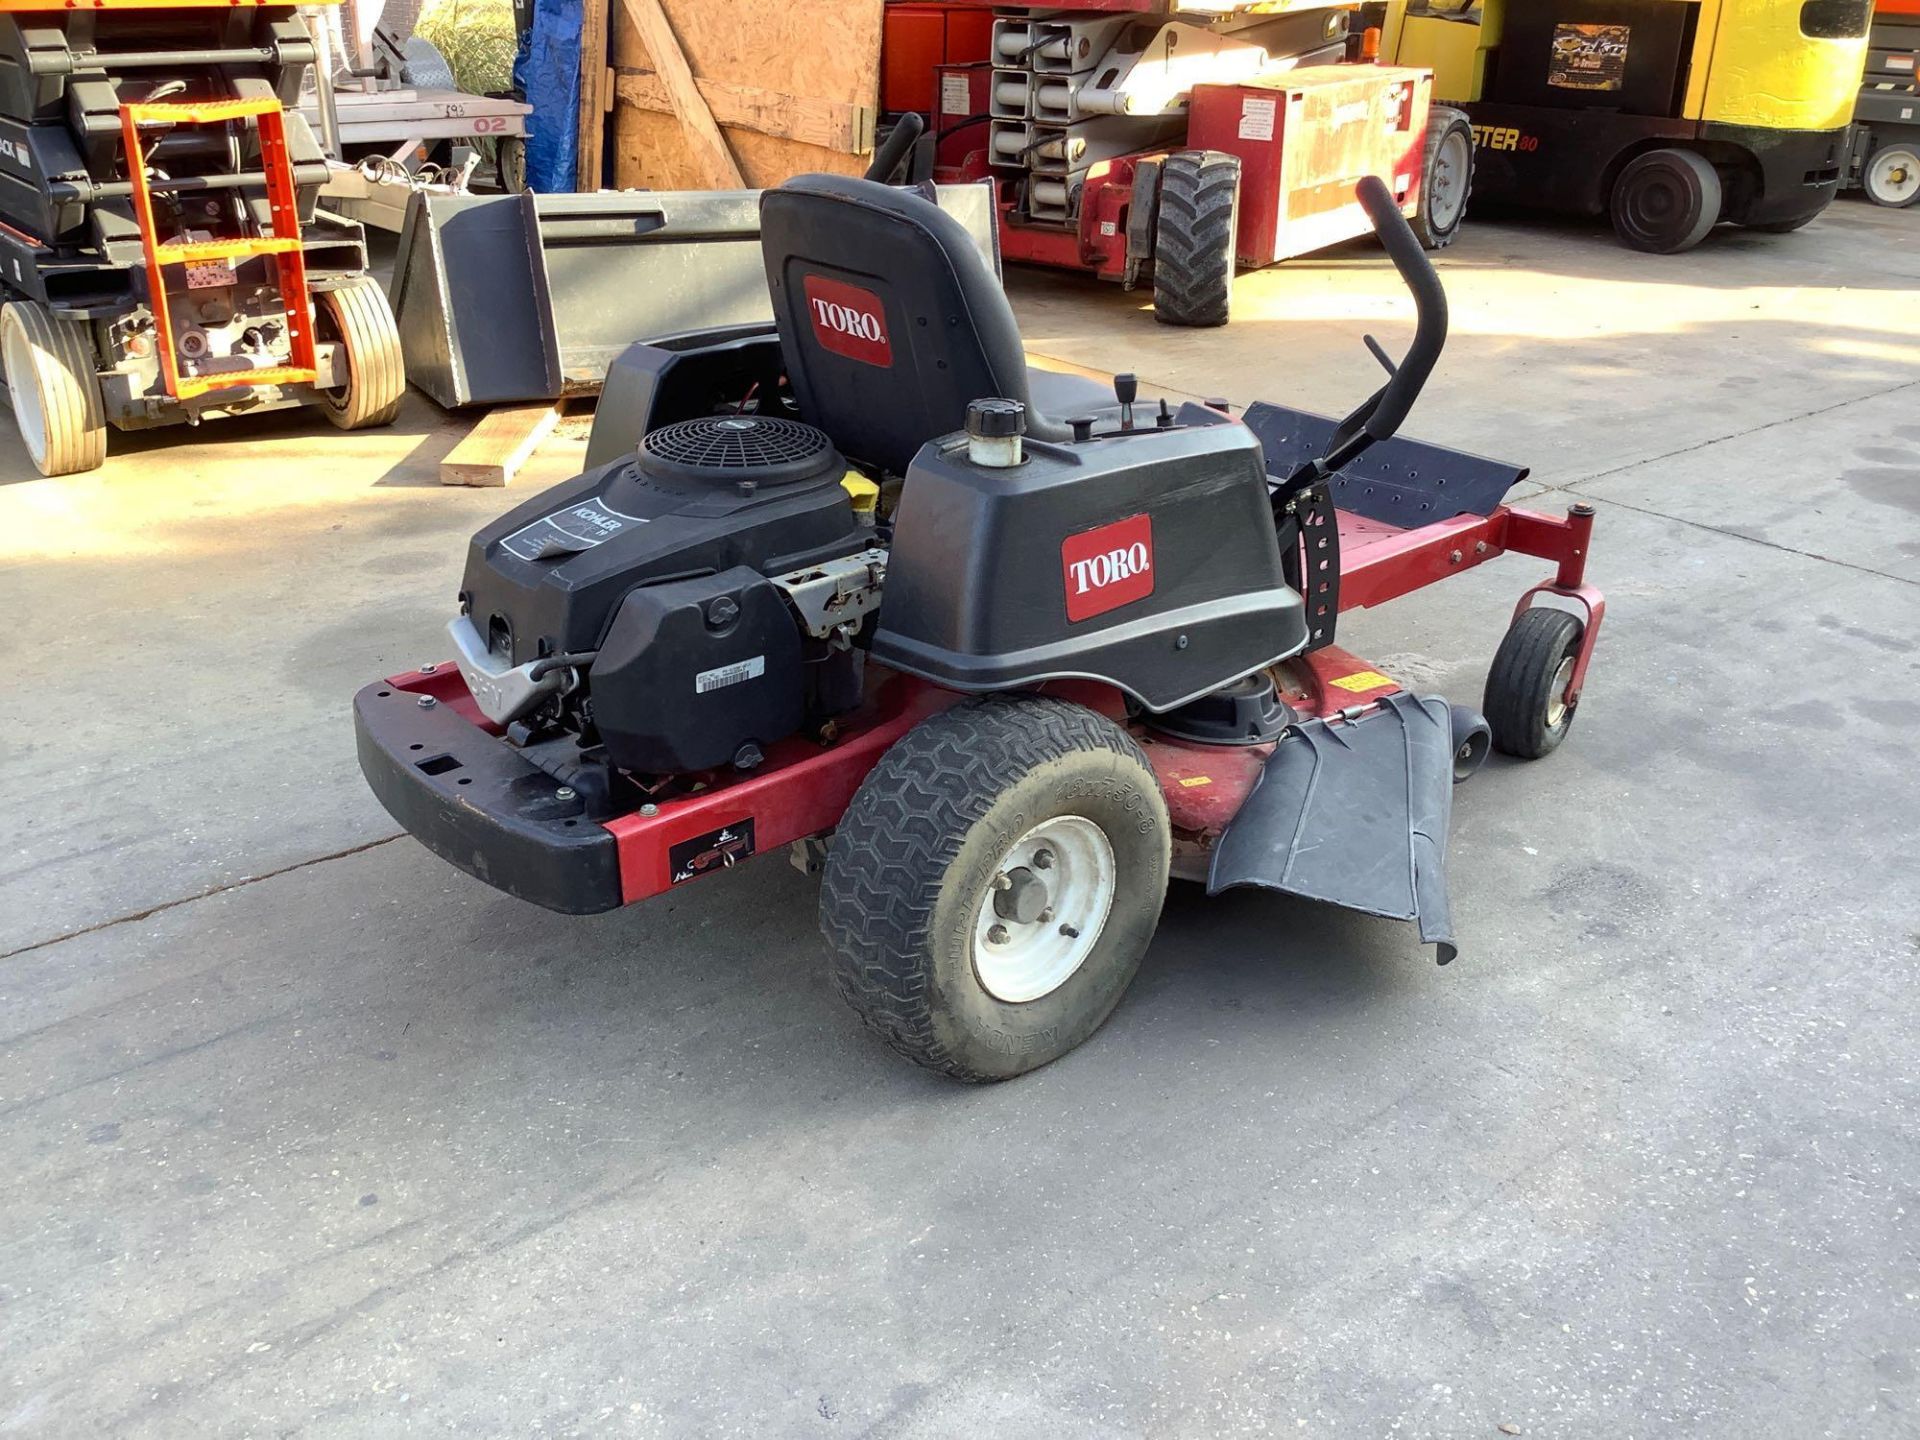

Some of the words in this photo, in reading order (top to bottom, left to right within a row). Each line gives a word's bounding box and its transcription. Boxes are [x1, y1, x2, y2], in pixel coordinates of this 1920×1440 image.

[474, 117, 506, 133] 02
[1519, 136, 1538, 151] 80
[812, 297, 881, 342] TORO
[571, 507, 622, 532] KOHLER
[1069, 542, 1147, 595] TORO
[972, 1016, 1059, 1057] KENDA
